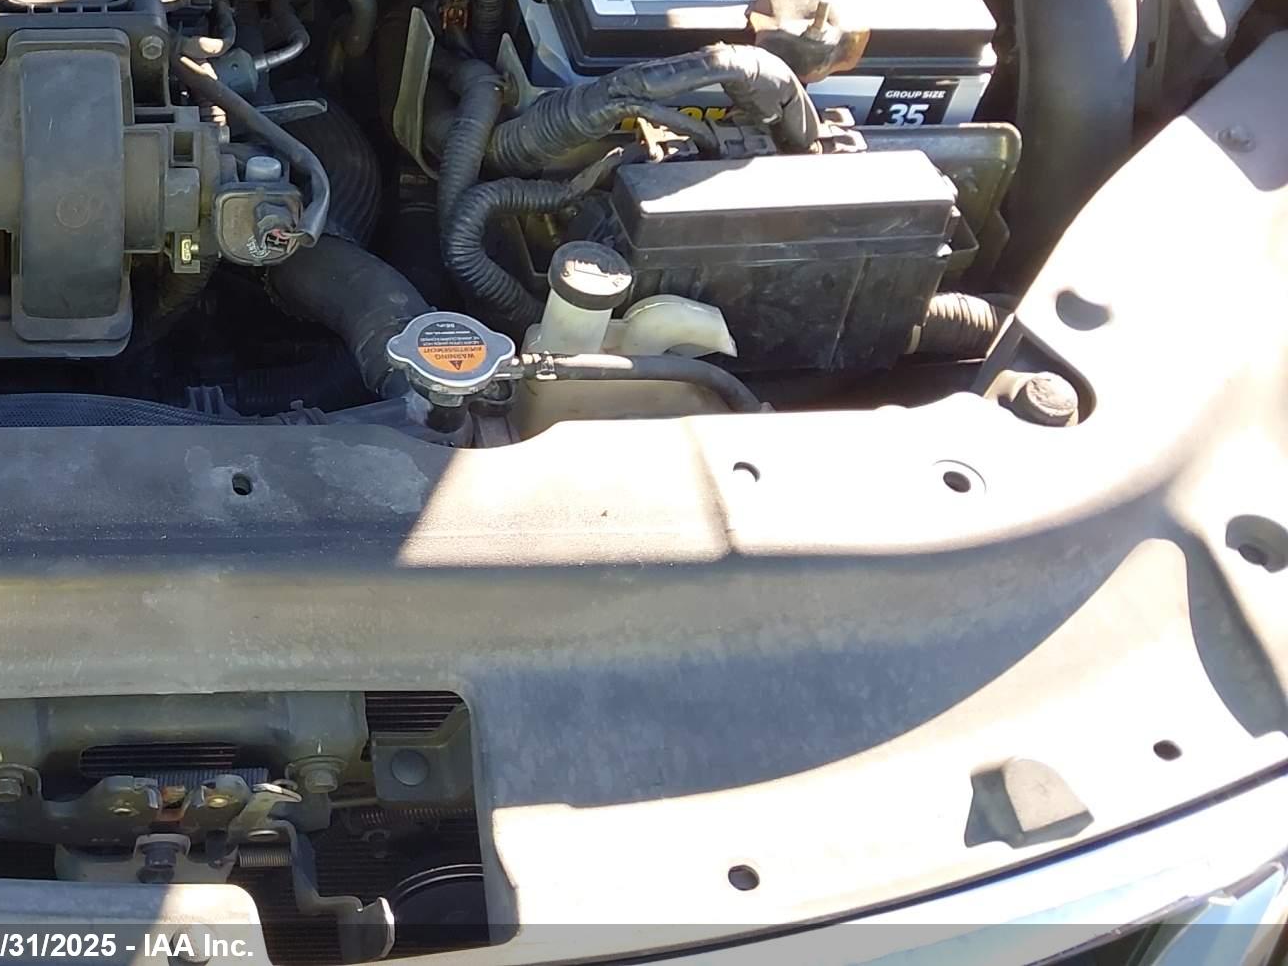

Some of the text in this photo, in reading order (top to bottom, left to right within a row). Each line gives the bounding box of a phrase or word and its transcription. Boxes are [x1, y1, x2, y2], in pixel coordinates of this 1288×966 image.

[884, 89, 947, 99] GROUP SIZE
[888, 103, 931, 128] 35
